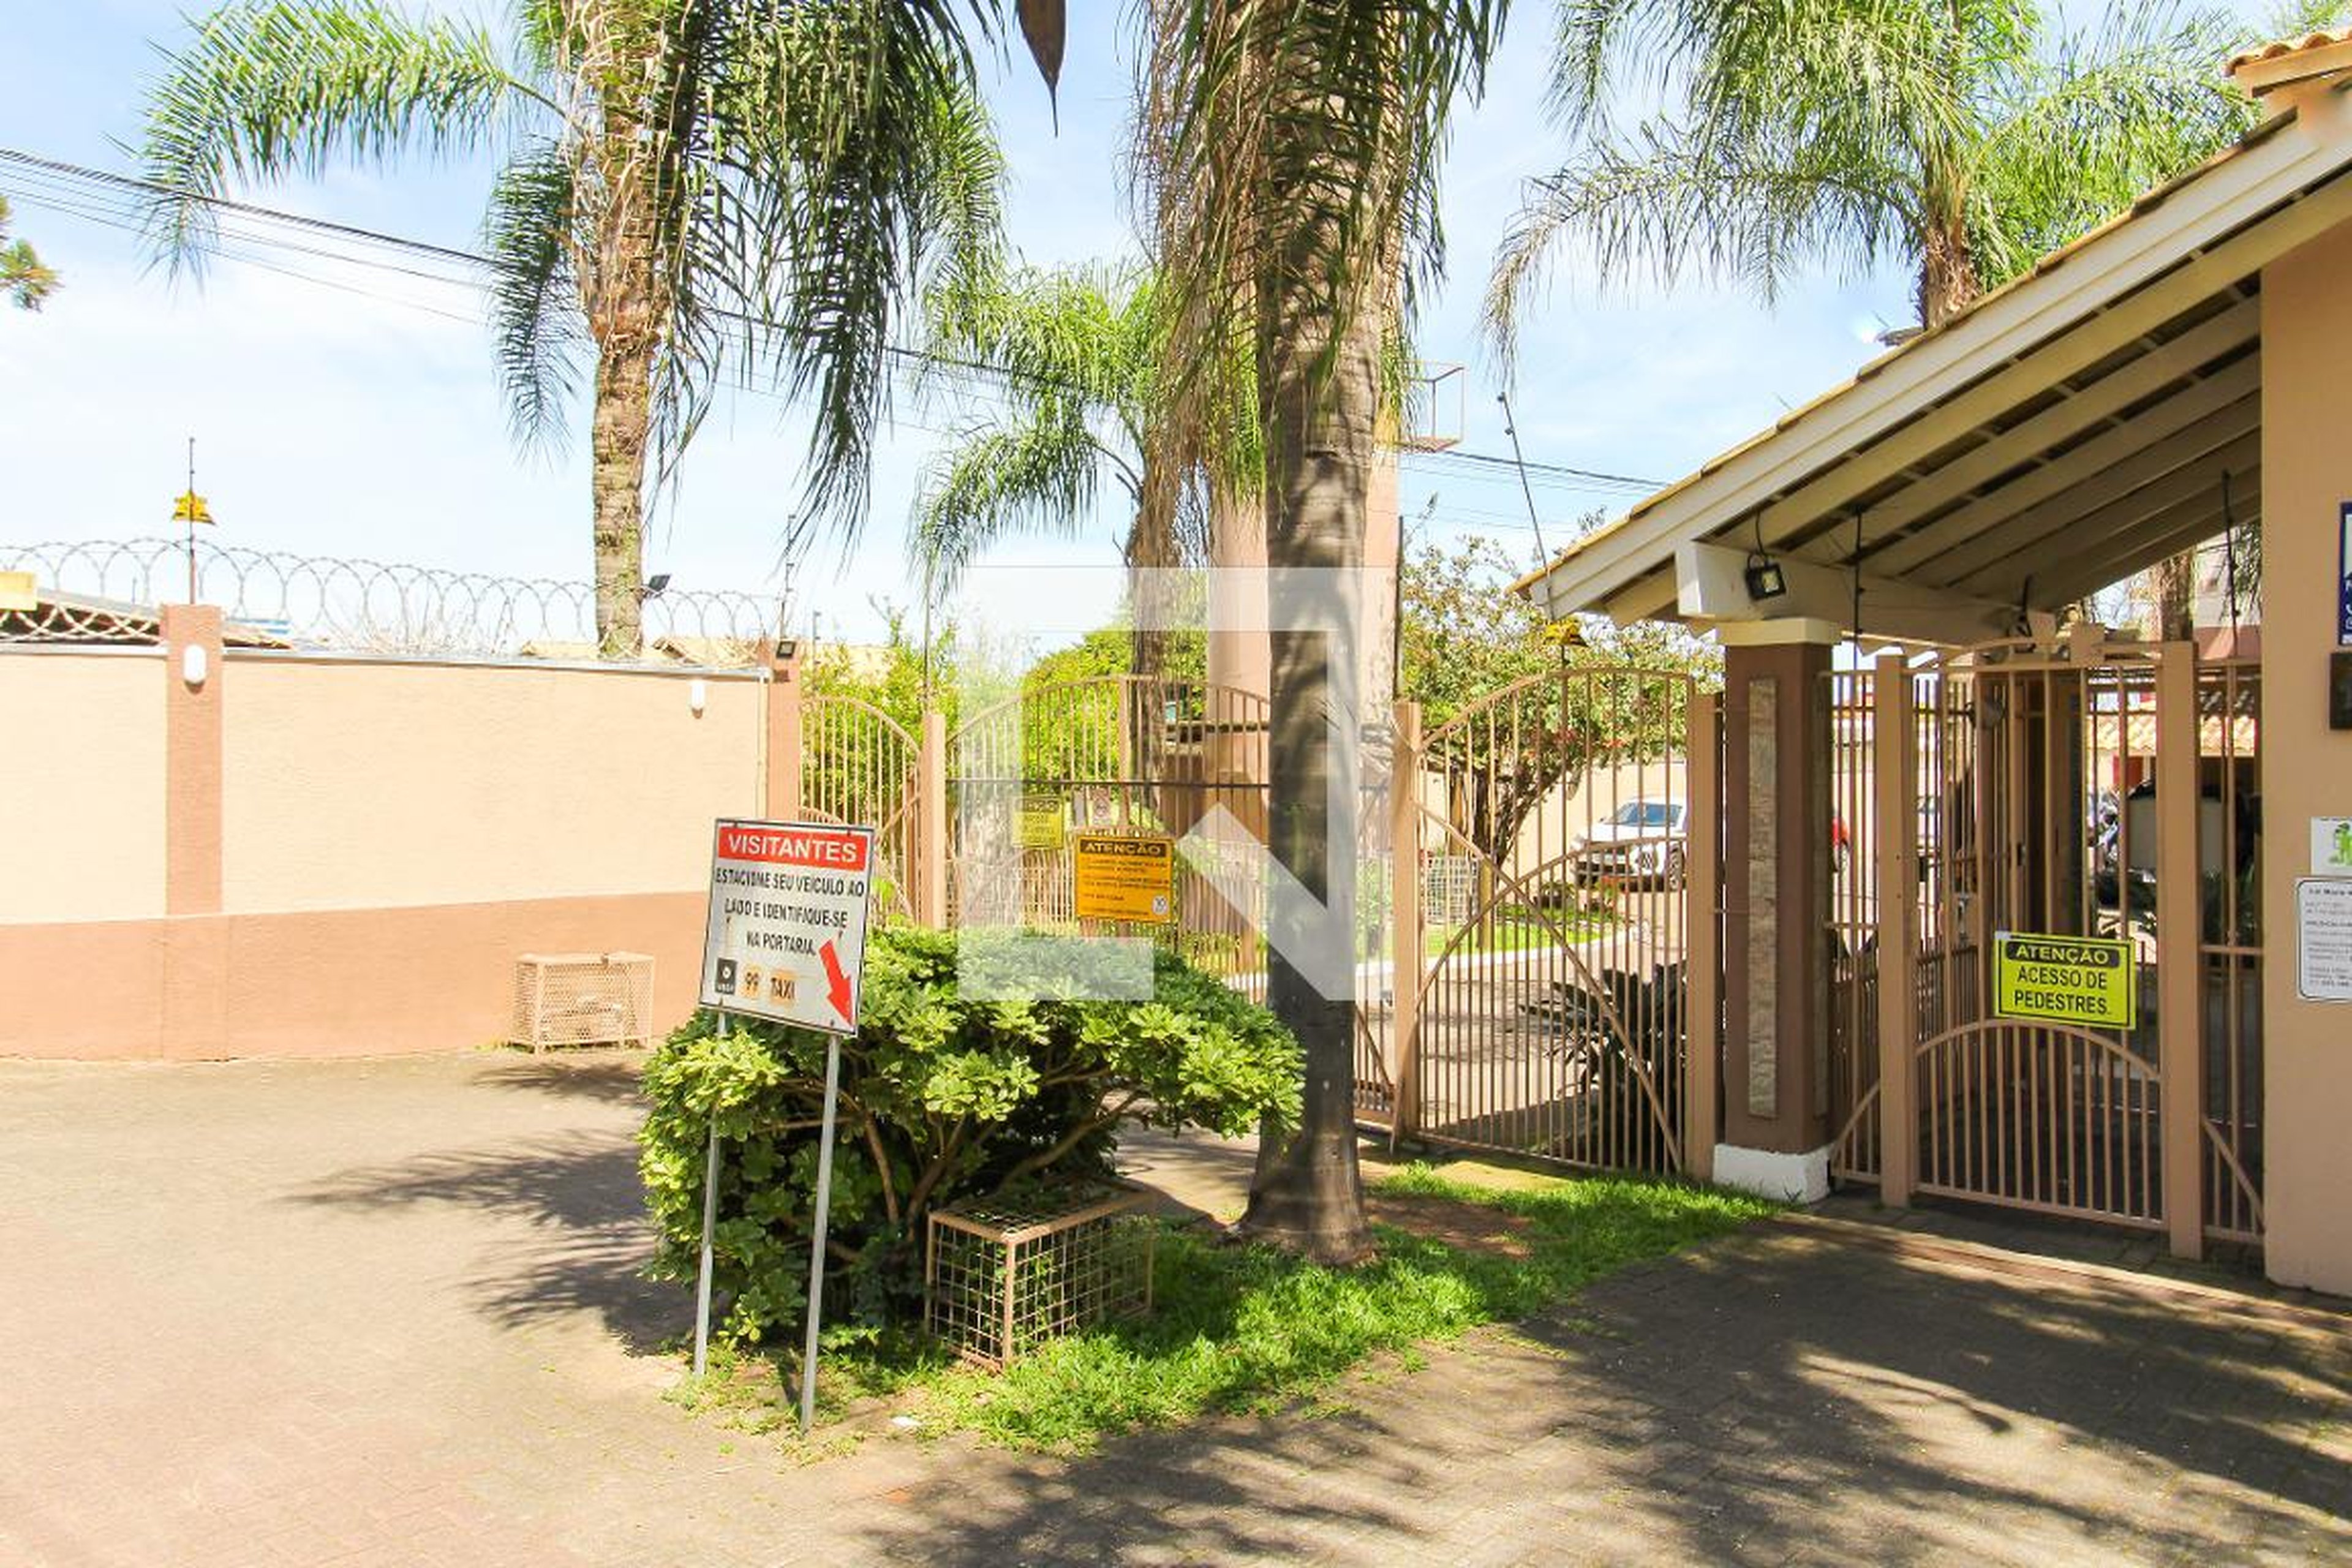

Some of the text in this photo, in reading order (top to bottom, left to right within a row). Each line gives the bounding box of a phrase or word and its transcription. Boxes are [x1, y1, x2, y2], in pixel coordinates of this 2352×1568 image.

[728, 834, 857, 862] VISITANTES
[773, 873, 794, 891] SEU
[847, 881, 864, 897] AO
[725, 898, 848, 928] LADO E IDENTIFIQUE-SE
[746, 930, 760, 948] NA
[771, 977, 795, 1000] TAXI
[2017, 966, 2108, 990] ACESSO DE
